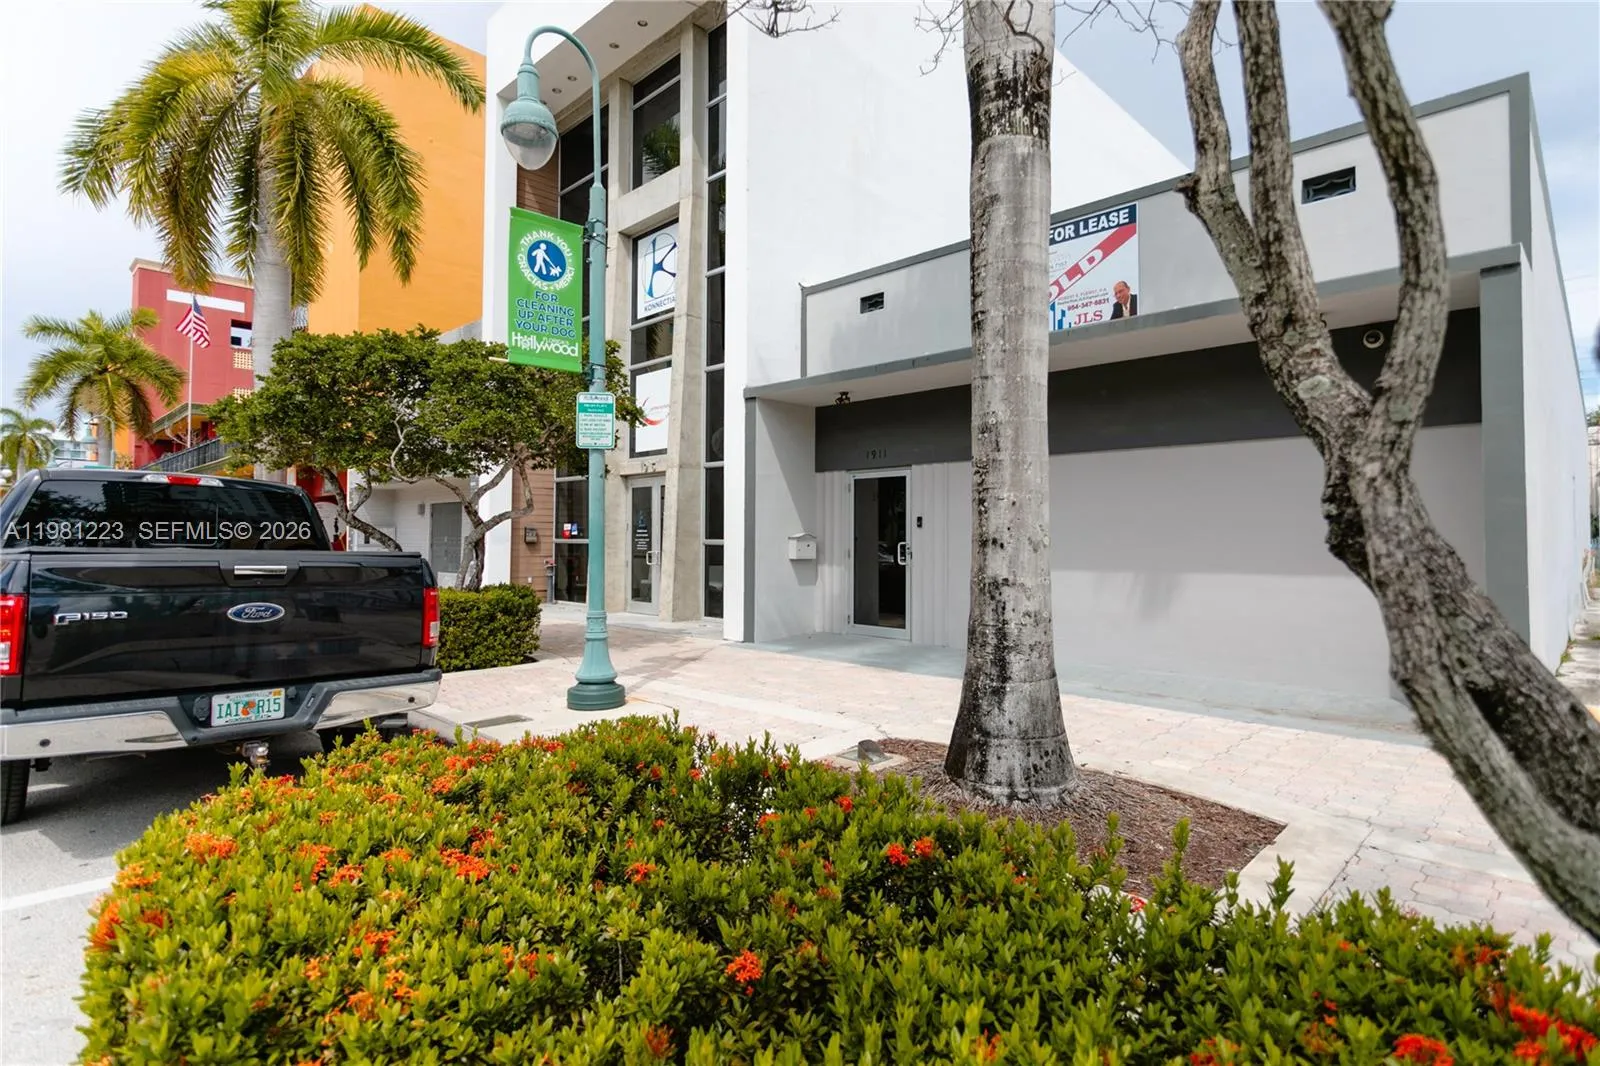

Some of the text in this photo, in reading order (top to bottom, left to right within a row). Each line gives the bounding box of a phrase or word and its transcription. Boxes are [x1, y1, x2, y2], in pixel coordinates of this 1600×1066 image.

[1049, 209, 1129, 241] FOR LEASE
[519, 230, 573, 258] THANK YOU
[517, 252, 576, 291] GRACIAS MERCI
[1048, 248, 1104, 303] OLD
[535, 290, 558, 302] FOR
[516, 298, 575, 317] CLEANING
[1073, 309, 1104, 325] JLS
[518, 309, 573, 327] UP AFTER
[515, 319, 576, 339] YOUR DOG
[511, 331, 579, 358] Hollywood
[866, 448, 887, 459] 1911
[240, 605, 273, 619] Ford
[217, 698, 281, 719] IAI R15
